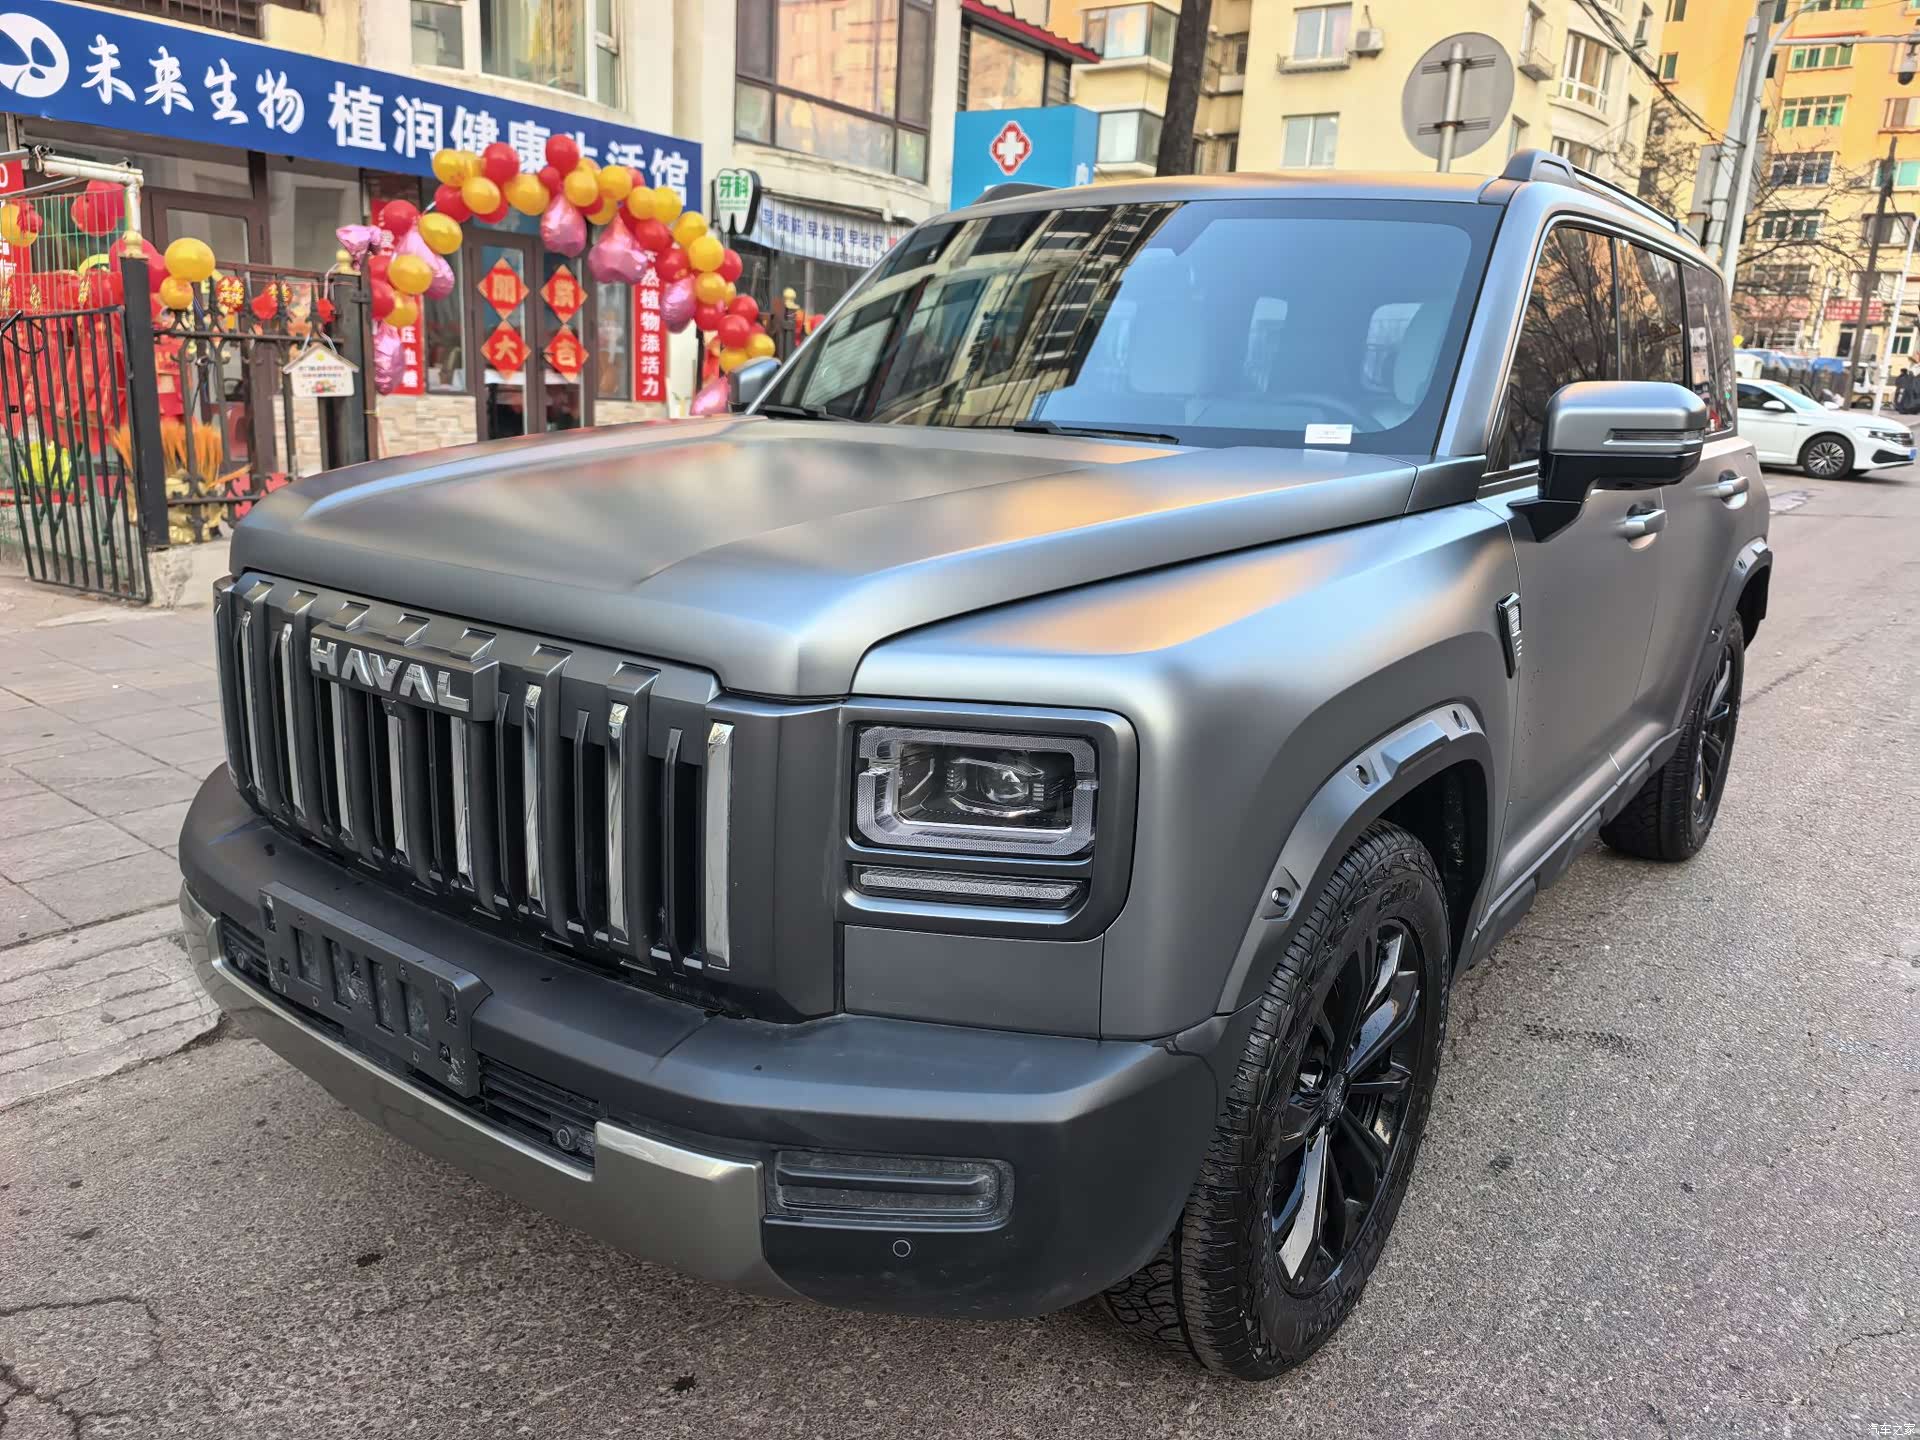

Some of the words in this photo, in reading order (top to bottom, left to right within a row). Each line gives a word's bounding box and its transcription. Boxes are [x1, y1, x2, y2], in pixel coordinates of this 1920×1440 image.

[80, 33, 305, 134] 未来生物
[719, 175, 749, 198] 牙科
[310, 637, 469, 713] HAVAL
